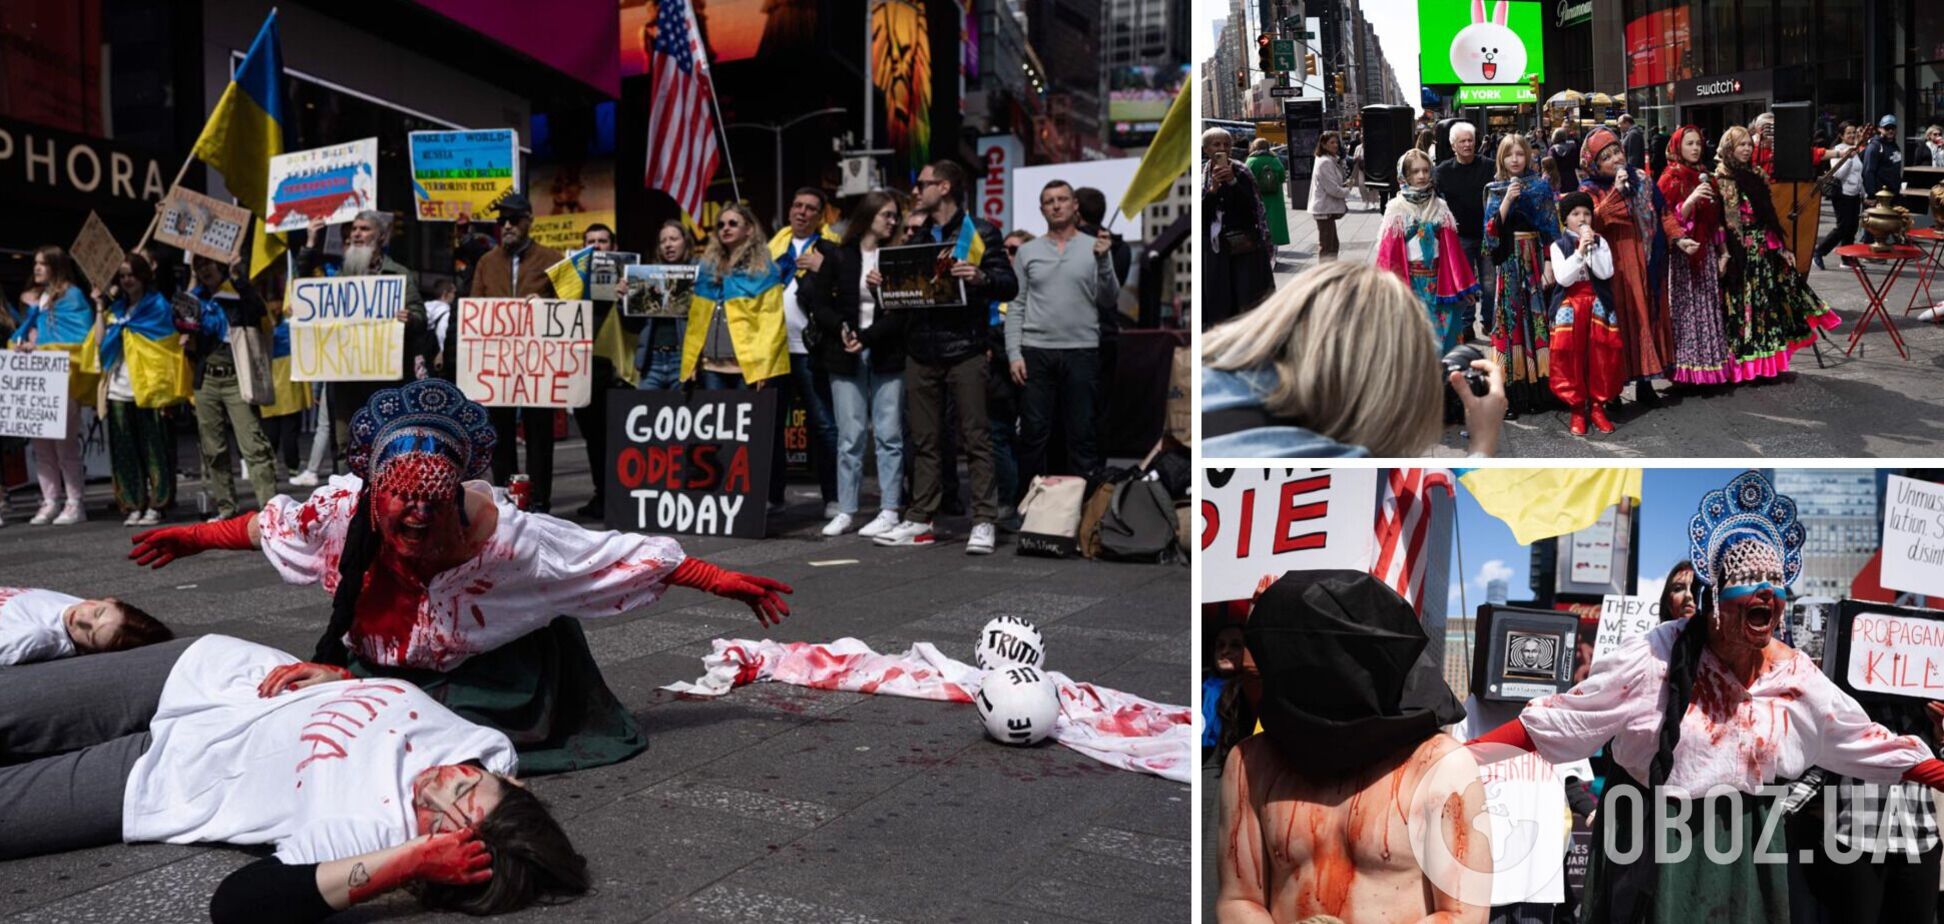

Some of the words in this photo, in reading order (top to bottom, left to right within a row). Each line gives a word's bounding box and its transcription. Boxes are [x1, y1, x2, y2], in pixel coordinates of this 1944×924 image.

[1471, 90, 1502, 99] YORK
[1696, 79, 1734, 96] swatch
[420, 201, 444, 217] GET
[297, 281, 360, 322] STAND
[361, 278, 403, 319] WITH
[462, 300, 534, 337] RUSSIA
[541, 301, 567, 338] IS
[570, 302, 585, 339] A
[10, 355, 70, 373] CELEBRATE
[295, 321, 398, 376] UKRAINE
[462, 337, 593, 376] TERRORIST
[1, 374, 46, 392] SUFFER
[474, 370, 569, 403] STATE
[11, 394, 27, 406] THE
[30, 394, 60, 409] CYCLE
[15, 407, 58, 422] RUSSIAN
[625, 402, 752, 443] GOOGLE
[617, 445, 751, 493] ODESA
[630, 489, 744, 535] TODAY
[1605, 599, 1645, 616] THEY
[1604, 618, 1628, 633] WE
[1852, 617, 1944, 648] PROPAGAN
[988, 630, 1040, 666] TRUTH
